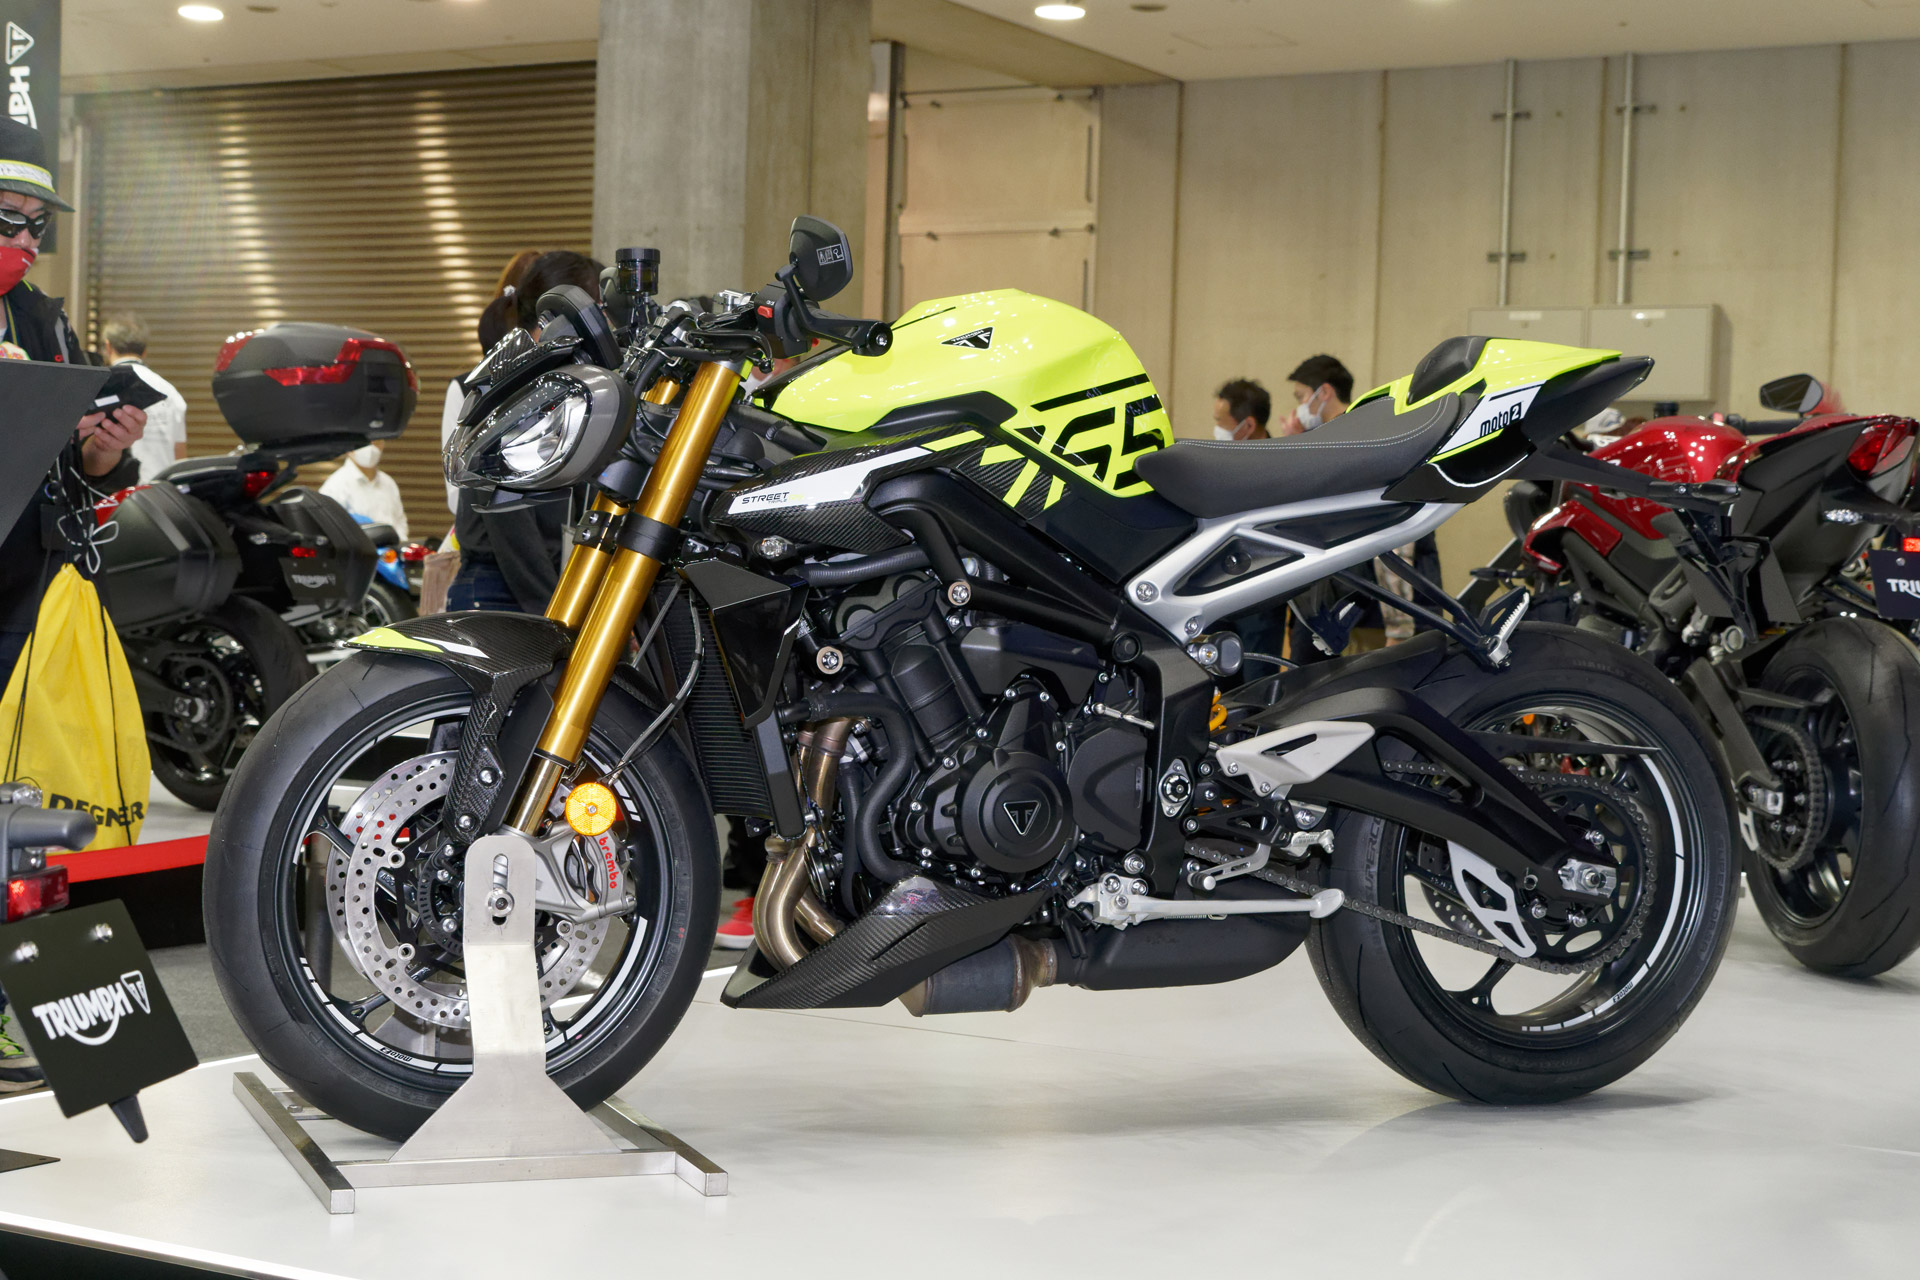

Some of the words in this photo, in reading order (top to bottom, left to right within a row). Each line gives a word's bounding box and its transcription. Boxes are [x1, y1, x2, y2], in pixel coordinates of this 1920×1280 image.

[1480, 401, 1522, 437] moto2
[741, 491, 790, 505] STREET
[599, 836, 619, 889] brembo
[32, 981, 134, 1046] TRIUMPH
